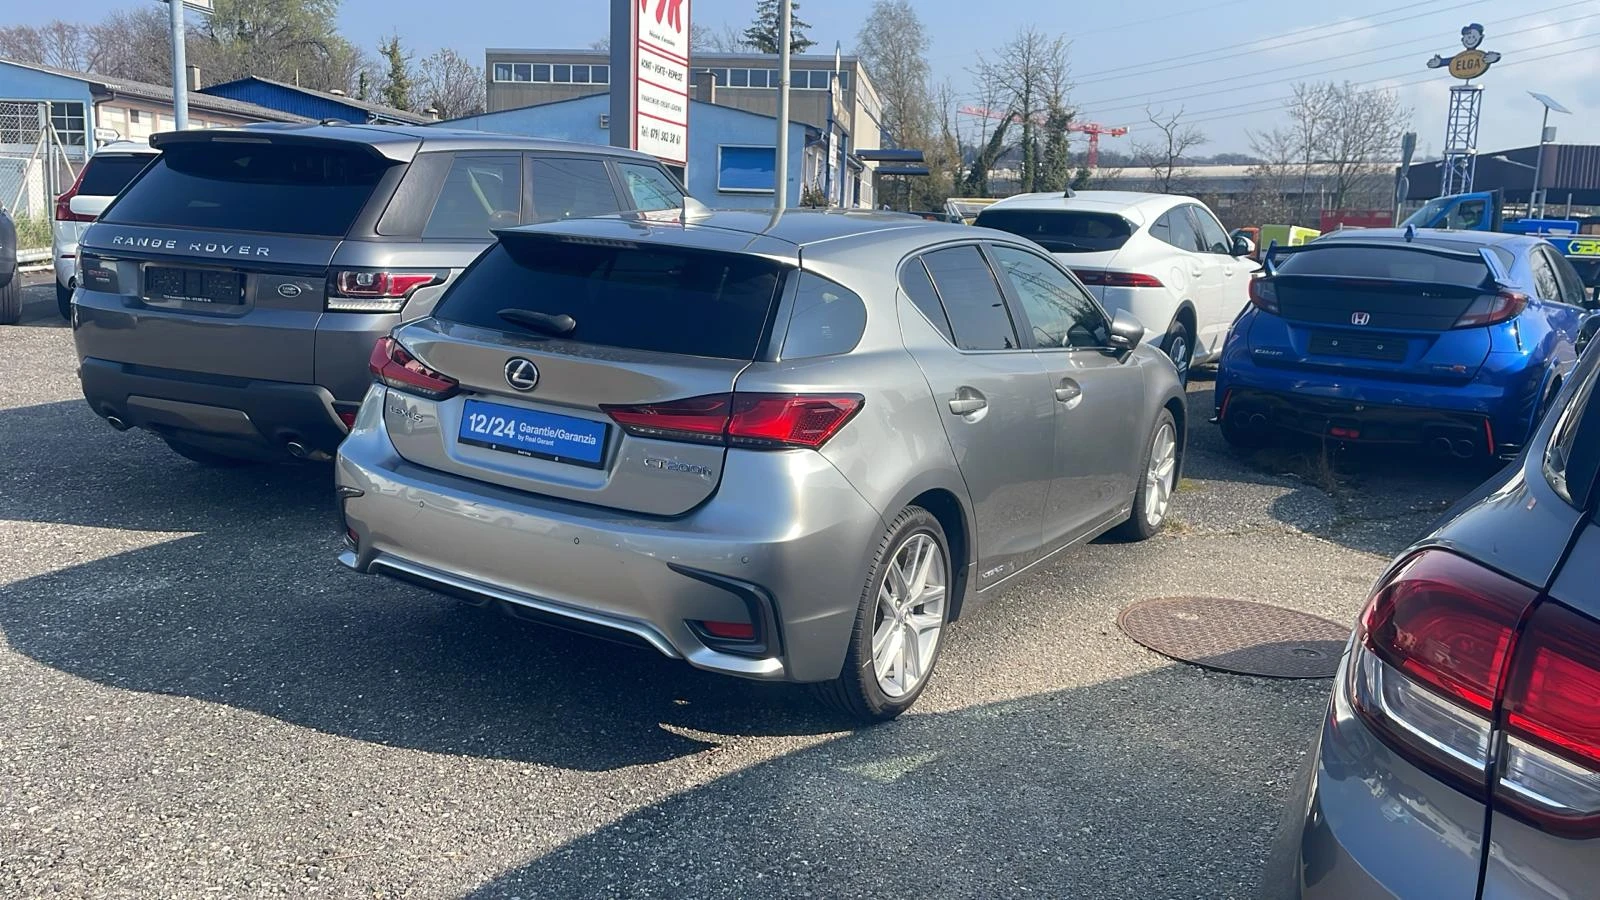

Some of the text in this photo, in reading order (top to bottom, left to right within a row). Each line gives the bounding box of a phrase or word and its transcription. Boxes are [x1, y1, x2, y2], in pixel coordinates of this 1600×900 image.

[1456, 59, 1481, 71] ELGA
[113, 236, 270, 256] RANGE ROVER
[390, 405, 424, 423] LEXUS
[469, 413, 597, 446] 12/24 Garantie/Garanzia
[517, 434, 555, 446] by Real Garant
